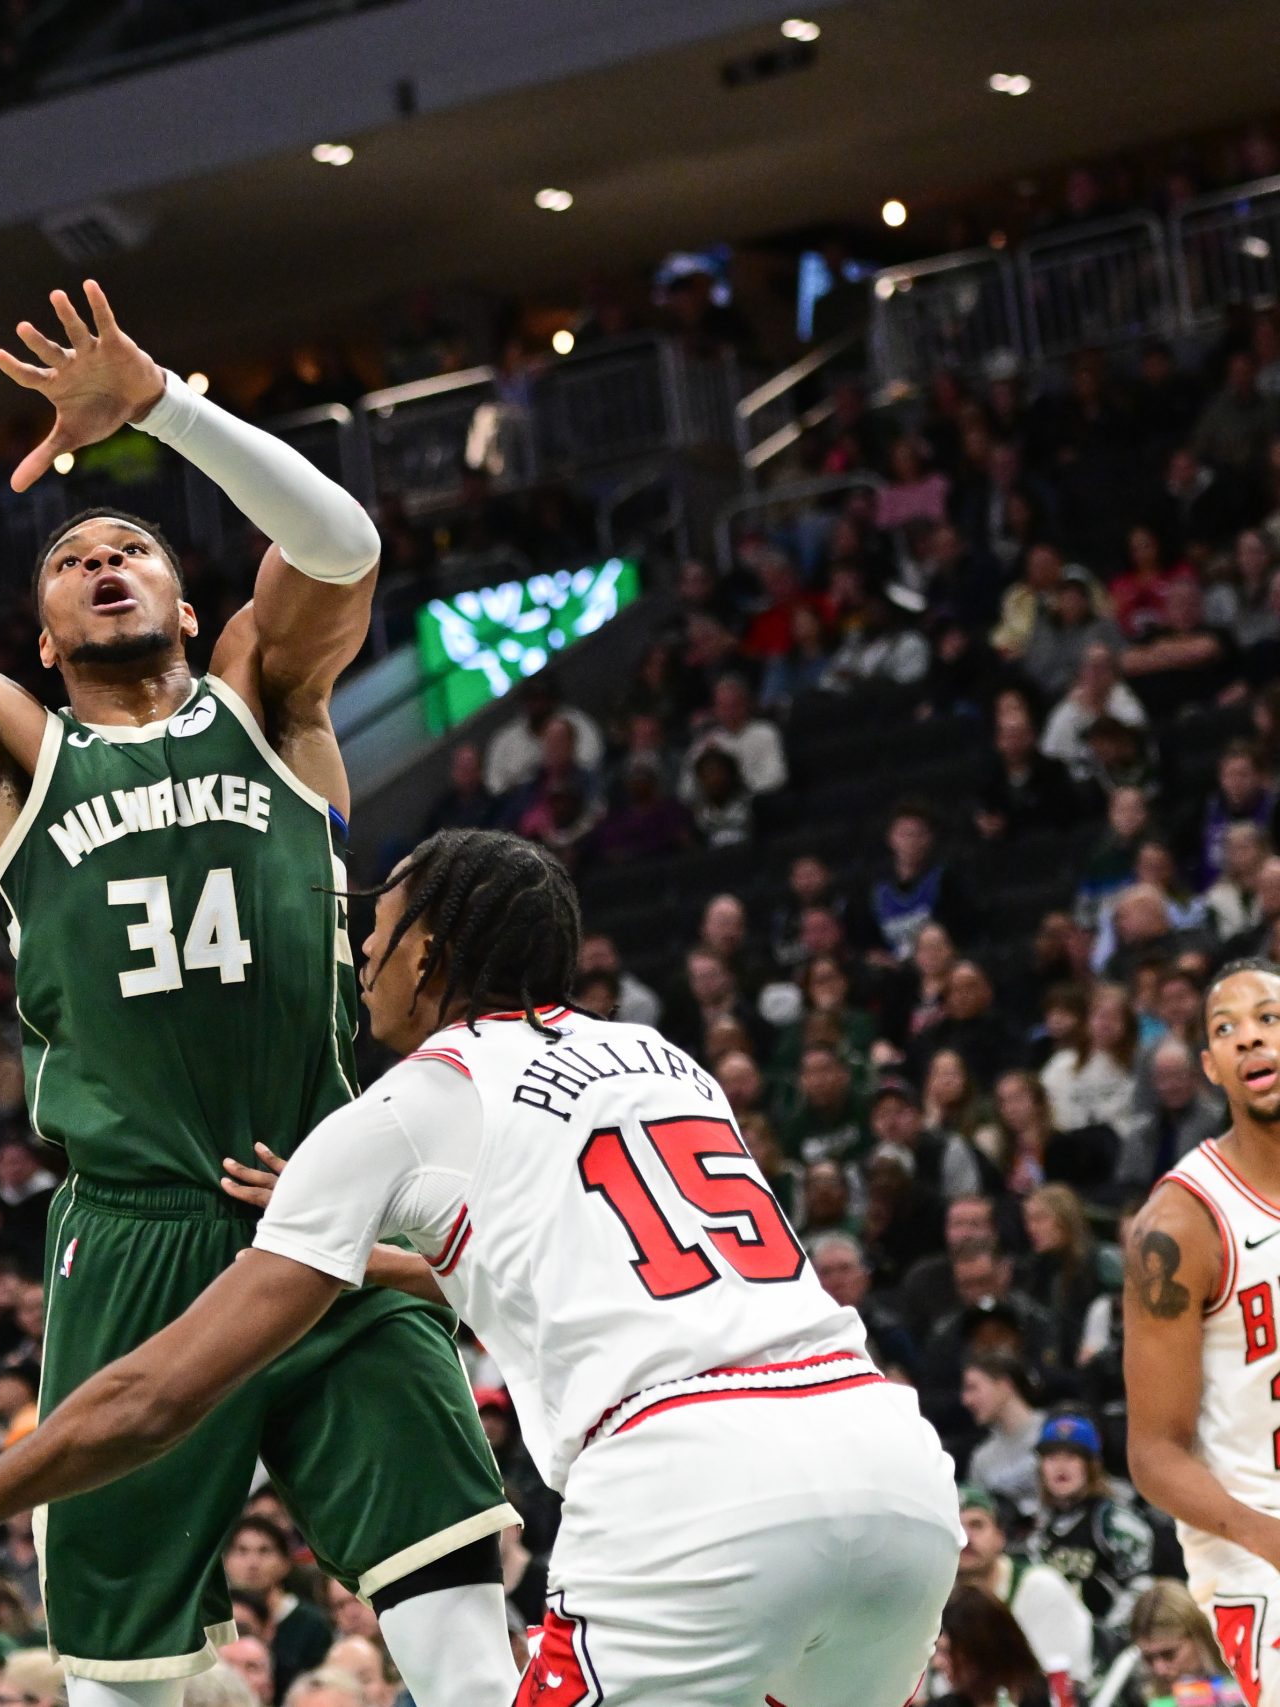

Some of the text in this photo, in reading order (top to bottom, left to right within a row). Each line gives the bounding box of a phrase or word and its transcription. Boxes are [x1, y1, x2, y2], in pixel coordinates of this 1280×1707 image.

[107, 867, 253, 998] 34
[512, 1039, 714, 1123] PHILLIPS
[577, 1115, 807, 1300] 15
[1236, 1274, 1280, 1366] B
